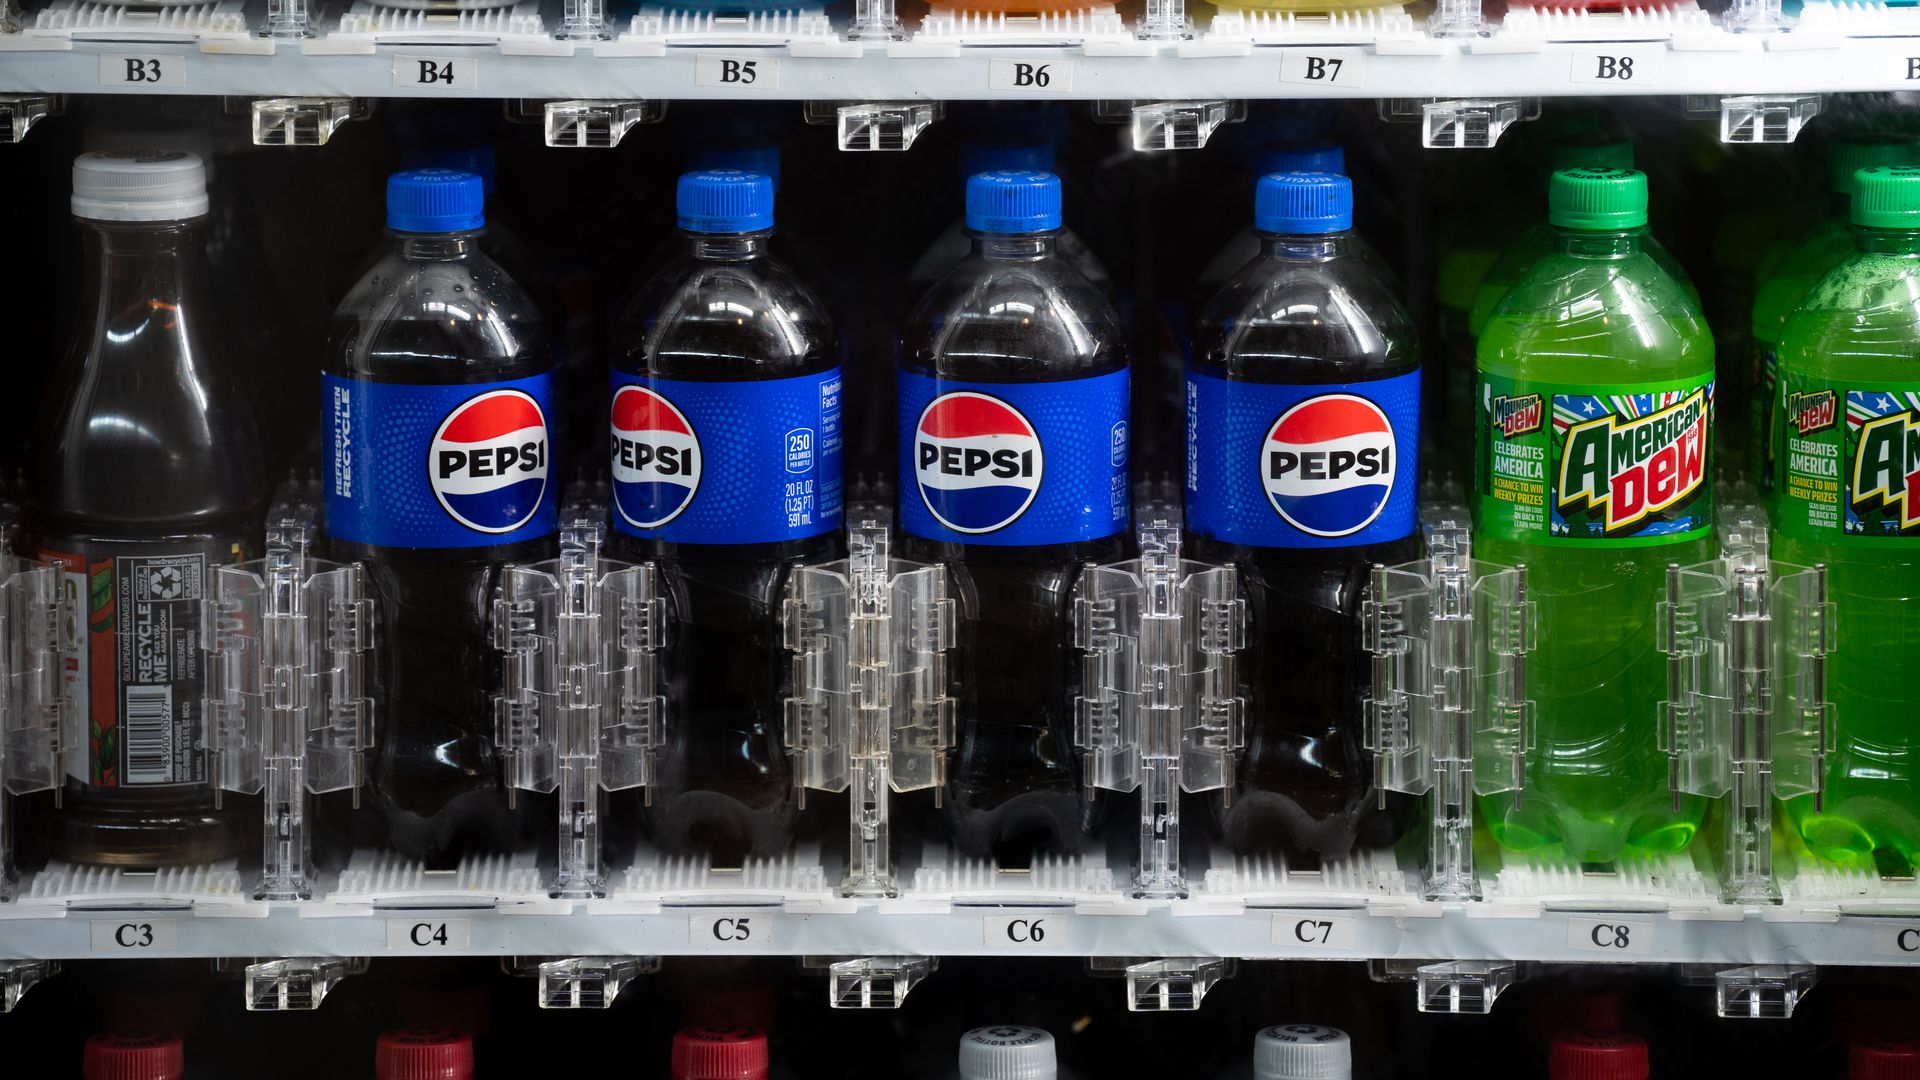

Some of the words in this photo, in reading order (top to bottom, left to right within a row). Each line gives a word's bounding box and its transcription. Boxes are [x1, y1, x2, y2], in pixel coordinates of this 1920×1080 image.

[125, 58, 162, 82] B3
[418, 60, 454, 84] B4
[720, 60, 757, 83] B5
[1014, 63, 1050, 87] B6
[1304, 57, 1343, 81] B7
[1596, 55, 1634, 79] B8
[1905, 57, 1920, 80] B
[334, 386, 342, 425] THEN
[822, 394, 838, 409] Facts
[342, 388, 352, 498] RECYCLE
[789, 434, 811, 452] 250
[1494, 440, 1544, 460] CELEBRATES
[1790, 438, 1838, 457] CELEBRATES
[334, 428, 343, 496] REFRESH
[439, 438, 545, 479] PEPSI
[788, 450, 811, 461] CALORIES
[920, 442, 1033, 479] PEPSI
[1271, 445, 1389, 480] PEPSI
[1494, 455, 1544, 479] AMERICA
[1790, 452, 1838, 476] AMERICA
[785, 483, 796, 497] 20
[797, 481, 804, 496] FL
[805, 479, 813, 493] OZ
[1499, 479, 1519, 491] CHANCE
[1520, 482, 1529, 492] TO
[1530, 483, 1544, 494] WIN
[1790, 486, 1811, 500] WEEKLY
[1812, 490, 1838, 503] PRIZES
[1794, 476, 1814, 489] CHANCE
[1815, 479, 1823, 489] TO
[1824, 481, 1838, 491] WIN
[785, 497, 802, 514] (1.25
[803, 495, 815, 511] PT)
[1494, 488, 1516, 502] WEEKLY
[1518, 492, 1544, 506] PRIZES
[788, 512, 802, 528] 591
[802, 510, 812, 525] mL
[1536, 514, 1544, 522] TO
[1831, 513, 1838, 521] TO
[121, 577, 130, 681] GOLDPEAKBEVERAGES.COM
[138, 603, 152, 682] RECYCLE
[186, 630, 195, 658] OPENING
[153, 655, 167, 682] ME
[177, 638, 185, 680] REFRIGERATE
[187, 659, 196, 679] AFTER
[161, 702, 171, 731] 00577
[161, 735, 171, 765] 83900
[116, 923, 154, 947] C3
[411, 923, 448, 946] C4
[713, 918, 750, 941] C5
[1007, 919, 1045, 943] C6
[1295, 919, 1333, 943] C7
[1592, 924, 1630, 948] C8
[1898, 928, 1920, 951] C
